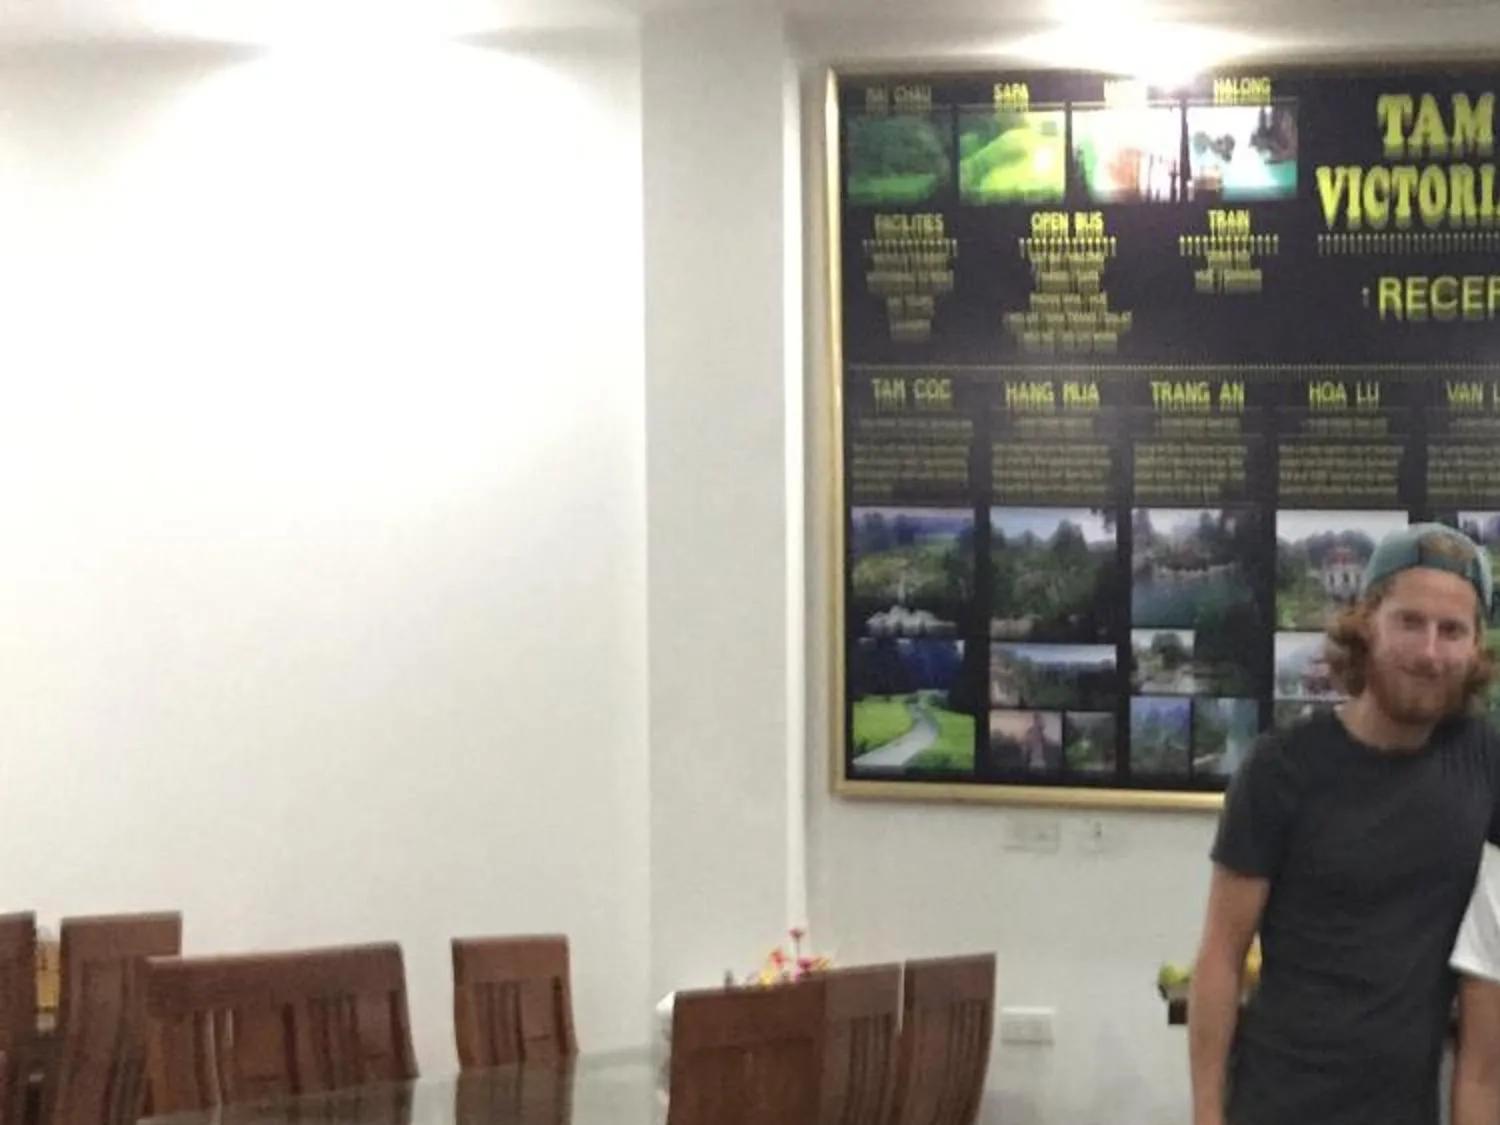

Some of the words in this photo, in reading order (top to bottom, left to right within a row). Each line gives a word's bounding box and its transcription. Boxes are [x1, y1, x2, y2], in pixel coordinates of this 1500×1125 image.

[993, 82, 1029, 111] SAPA
[1377, 92, 1495, 157] TAM
[1208, 209, 1249, 234] TRAIN
[871, 378, 906, 407] TAM
[1150, 381, 1211, 410] TRANG
[1219, 380, 1245, 410] AN
[1308, 381, 1347, 411] HOA
[1446, 381, 1484, 409] VAN
